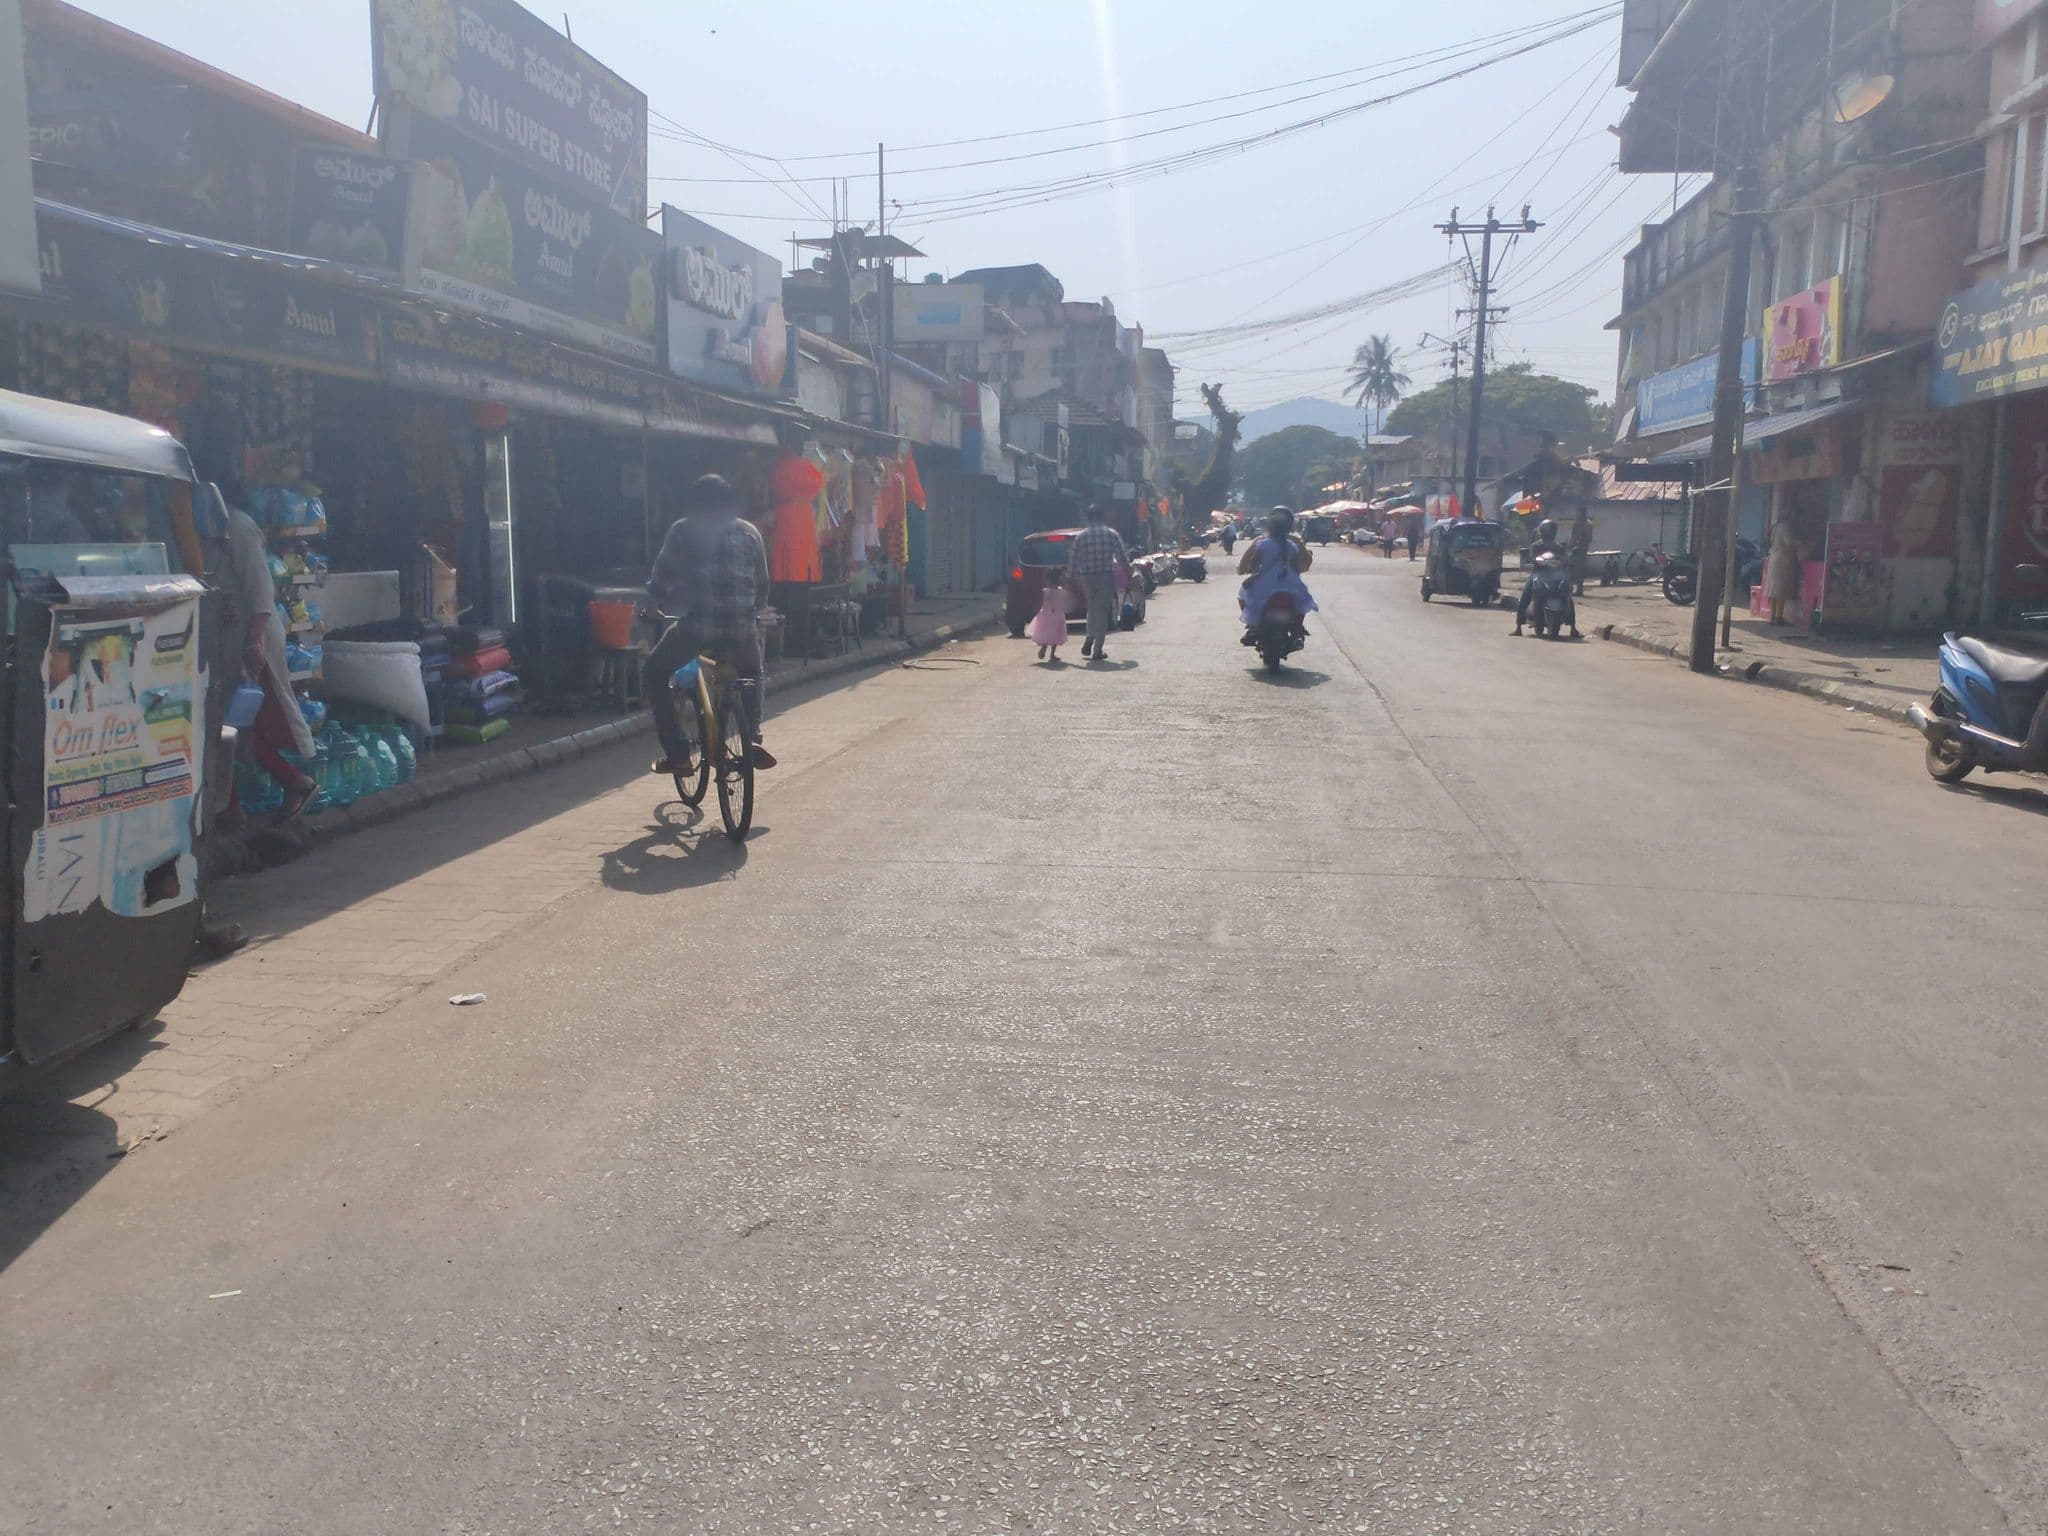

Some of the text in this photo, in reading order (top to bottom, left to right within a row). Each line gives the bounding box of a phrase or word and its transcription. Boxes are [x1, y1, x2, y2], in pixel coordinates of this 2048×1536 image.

[468, 85, 612, 192] SAI SUPER STORE
[537, 240, 573, 278] Amul
[284, 296, 336, 336] Amul
[1957, 336, 2007, 376] AJAY
[53, 713, 141, 755] Om flex
[37, 828, 45, 881] UBBALLI
